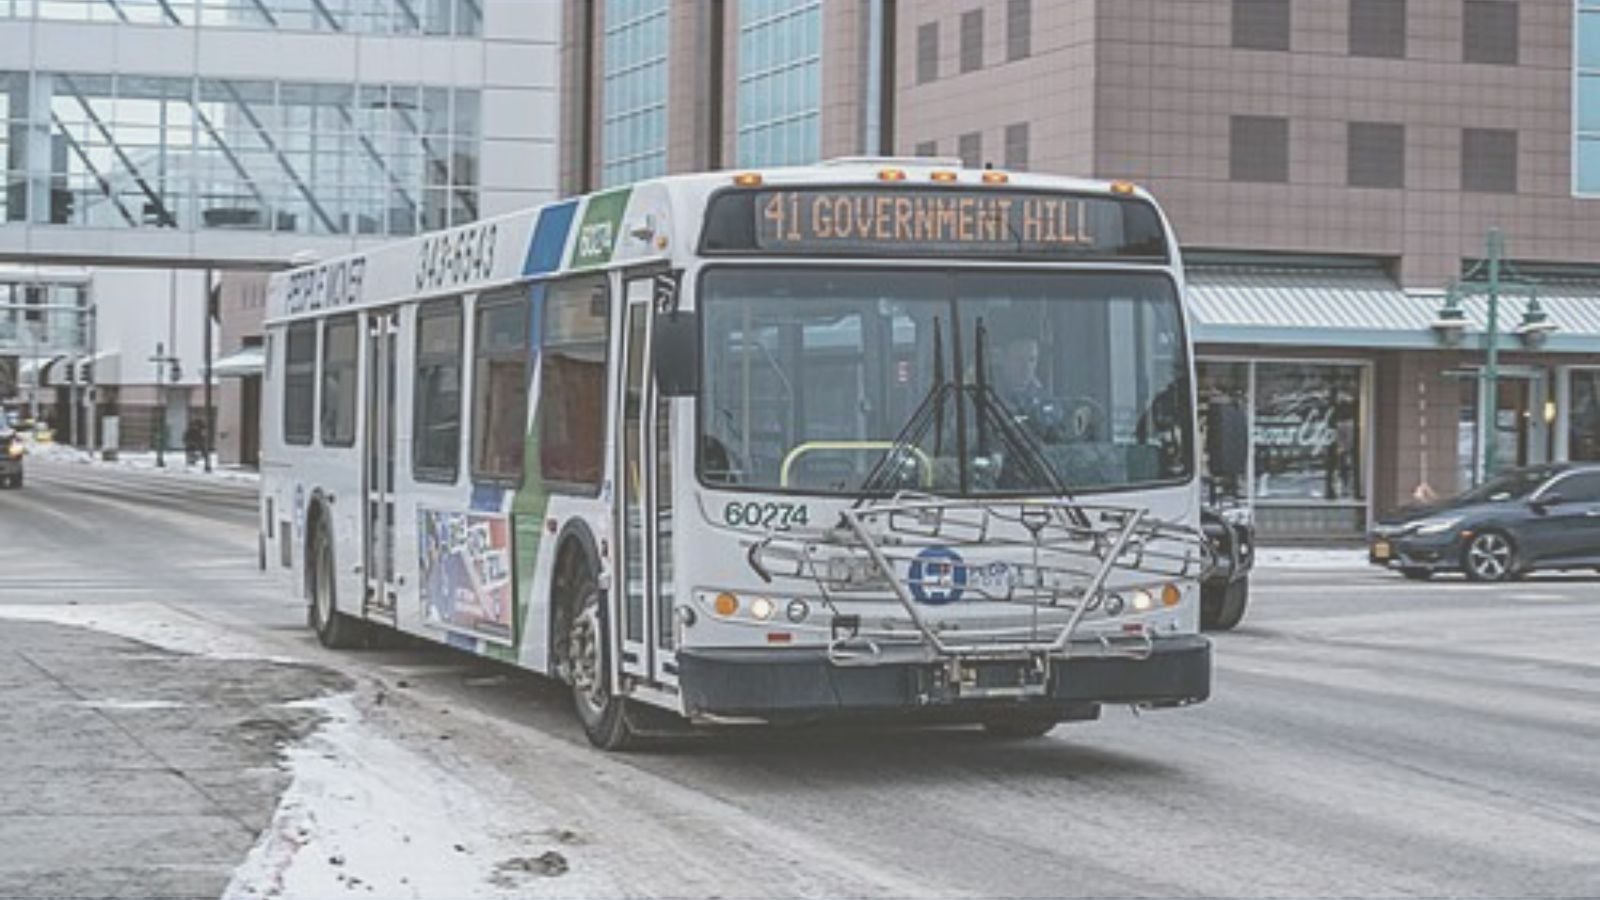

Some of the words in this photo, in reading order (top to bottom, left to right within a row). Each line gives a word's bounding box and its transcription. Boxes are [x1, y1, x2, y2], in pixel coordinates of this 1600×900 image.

[764, 191, 801, 240] 41
[812, 196, 1012, 241] GOVERNMENT
[1024, 200, 1095, 243] HILL
[415, 223, 497, 289] 343-6543
[725, 502, 809, 527] 60274
